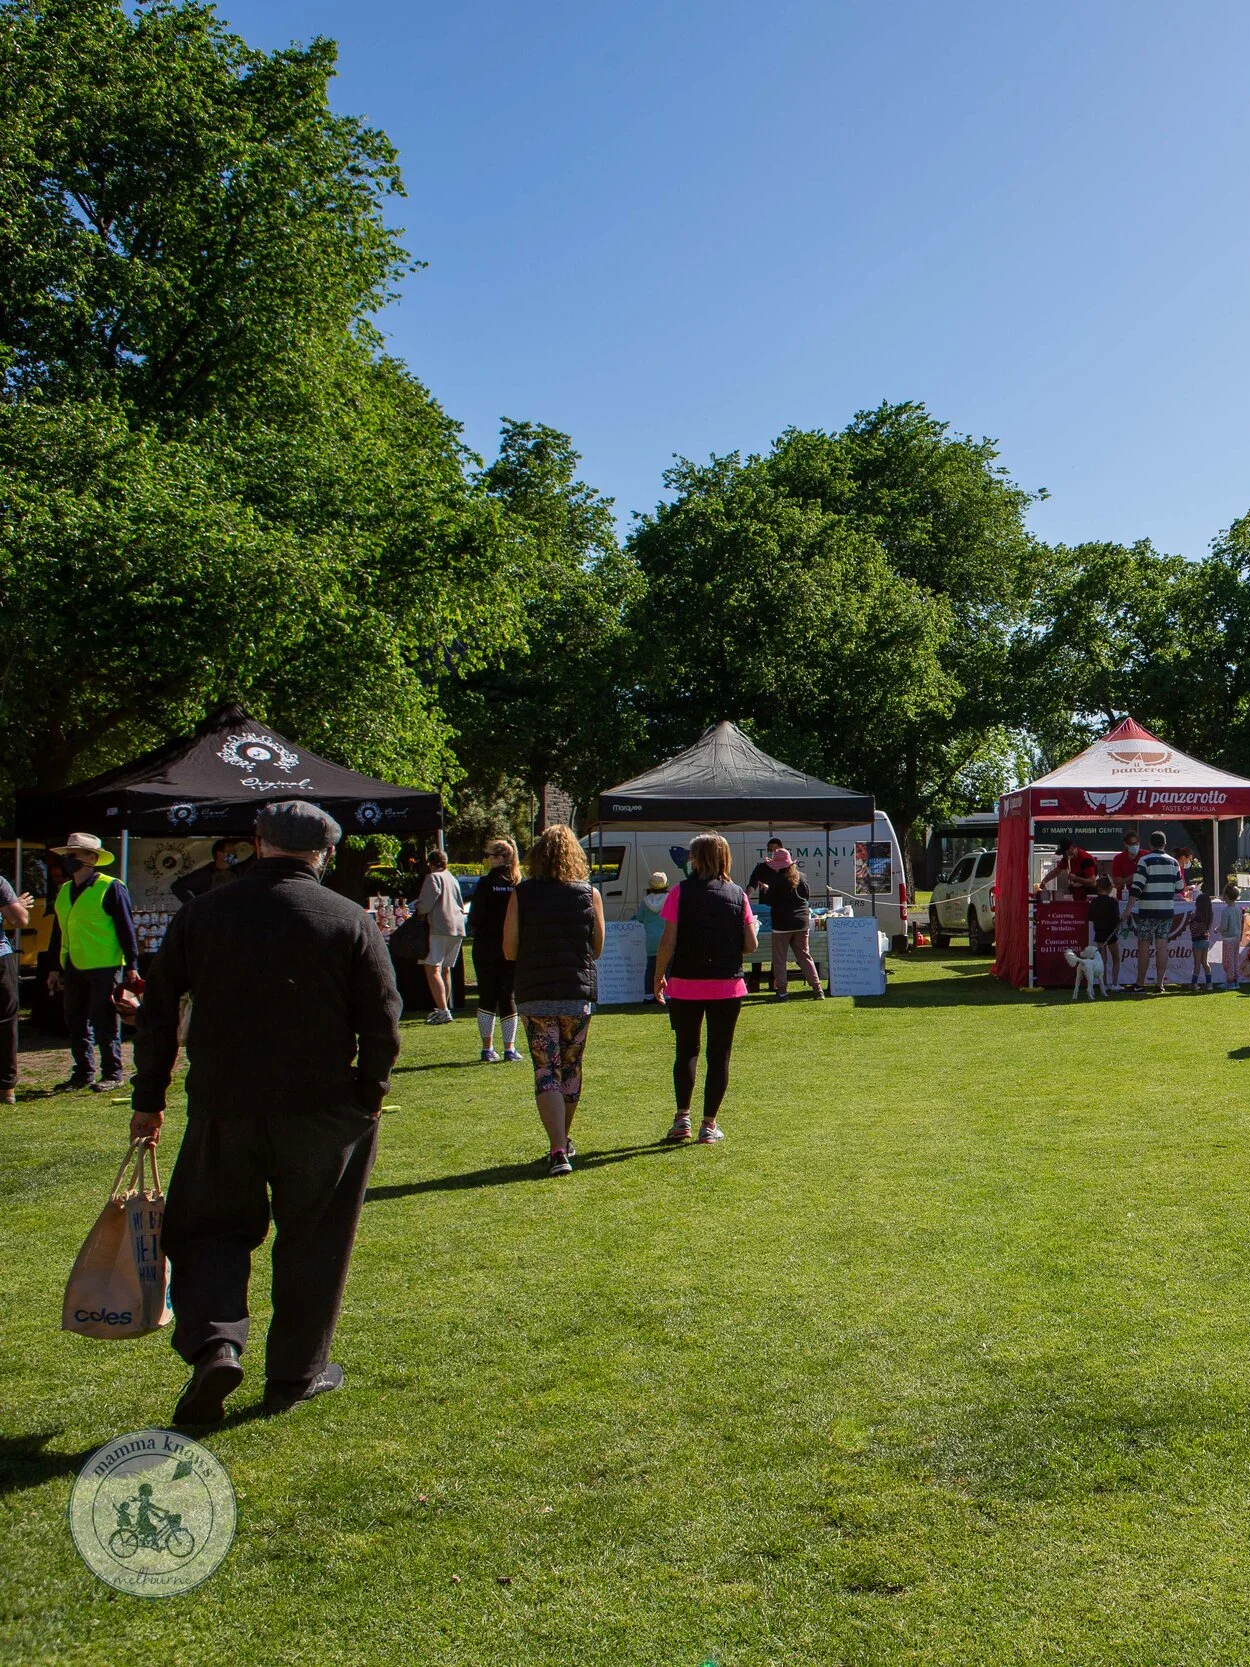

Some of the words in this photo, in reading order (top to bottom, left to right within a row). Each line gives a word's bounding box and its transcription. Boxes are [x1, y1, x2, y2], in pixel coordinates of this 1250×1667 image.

[1112, 766, 1180, 775] panzerotto
[1136, 790, 1147, 803] il
[1149, 790, 1229, 808] panzerotto
[74, 1308, 132, 1325] coles
